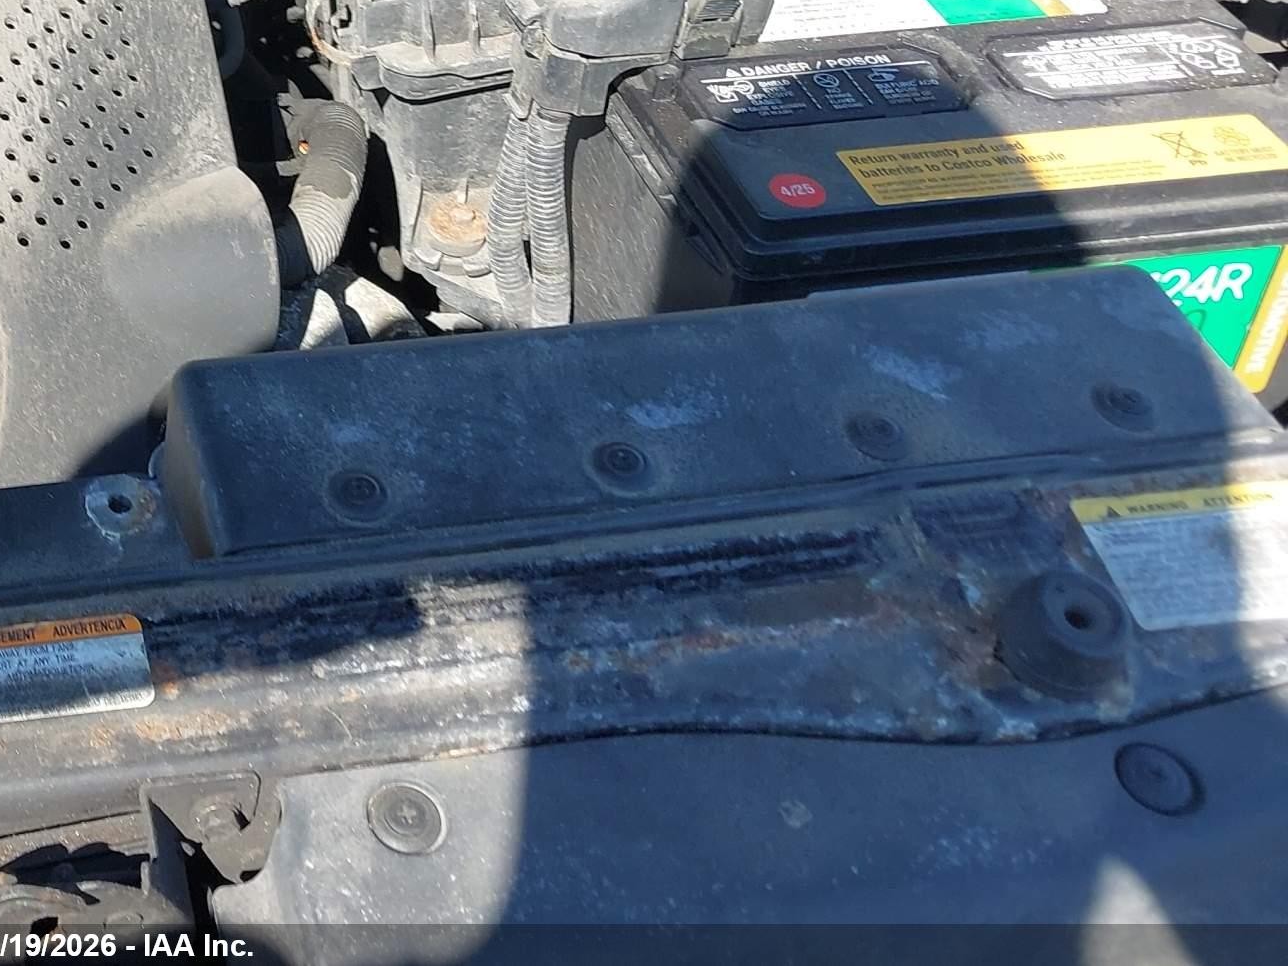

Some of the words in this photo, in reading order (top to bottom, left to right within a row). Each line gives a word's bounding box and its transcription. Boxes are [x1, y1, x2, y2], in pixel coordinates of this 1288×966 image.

[740, 62, 810, 77] DANGER
[826, 54, 891, 69] POISON
[848, 149, 897, 166] Return
[899, 147, 958, 162] warranty
[961, 144, 988, 155] and
[992, 140, 1025, 153] used
[859, 164, 923, 179] batteries
[926, 162, 940, 173] to
[943, 158, 992, 172] Costco
[994, 151, 1065, 166] Wholesale
[780, 183, 815, 197] 4/25
[1126, 500, 1189, 514] WARNING
[52, 619, 128, 638] ADVERTENCIA
